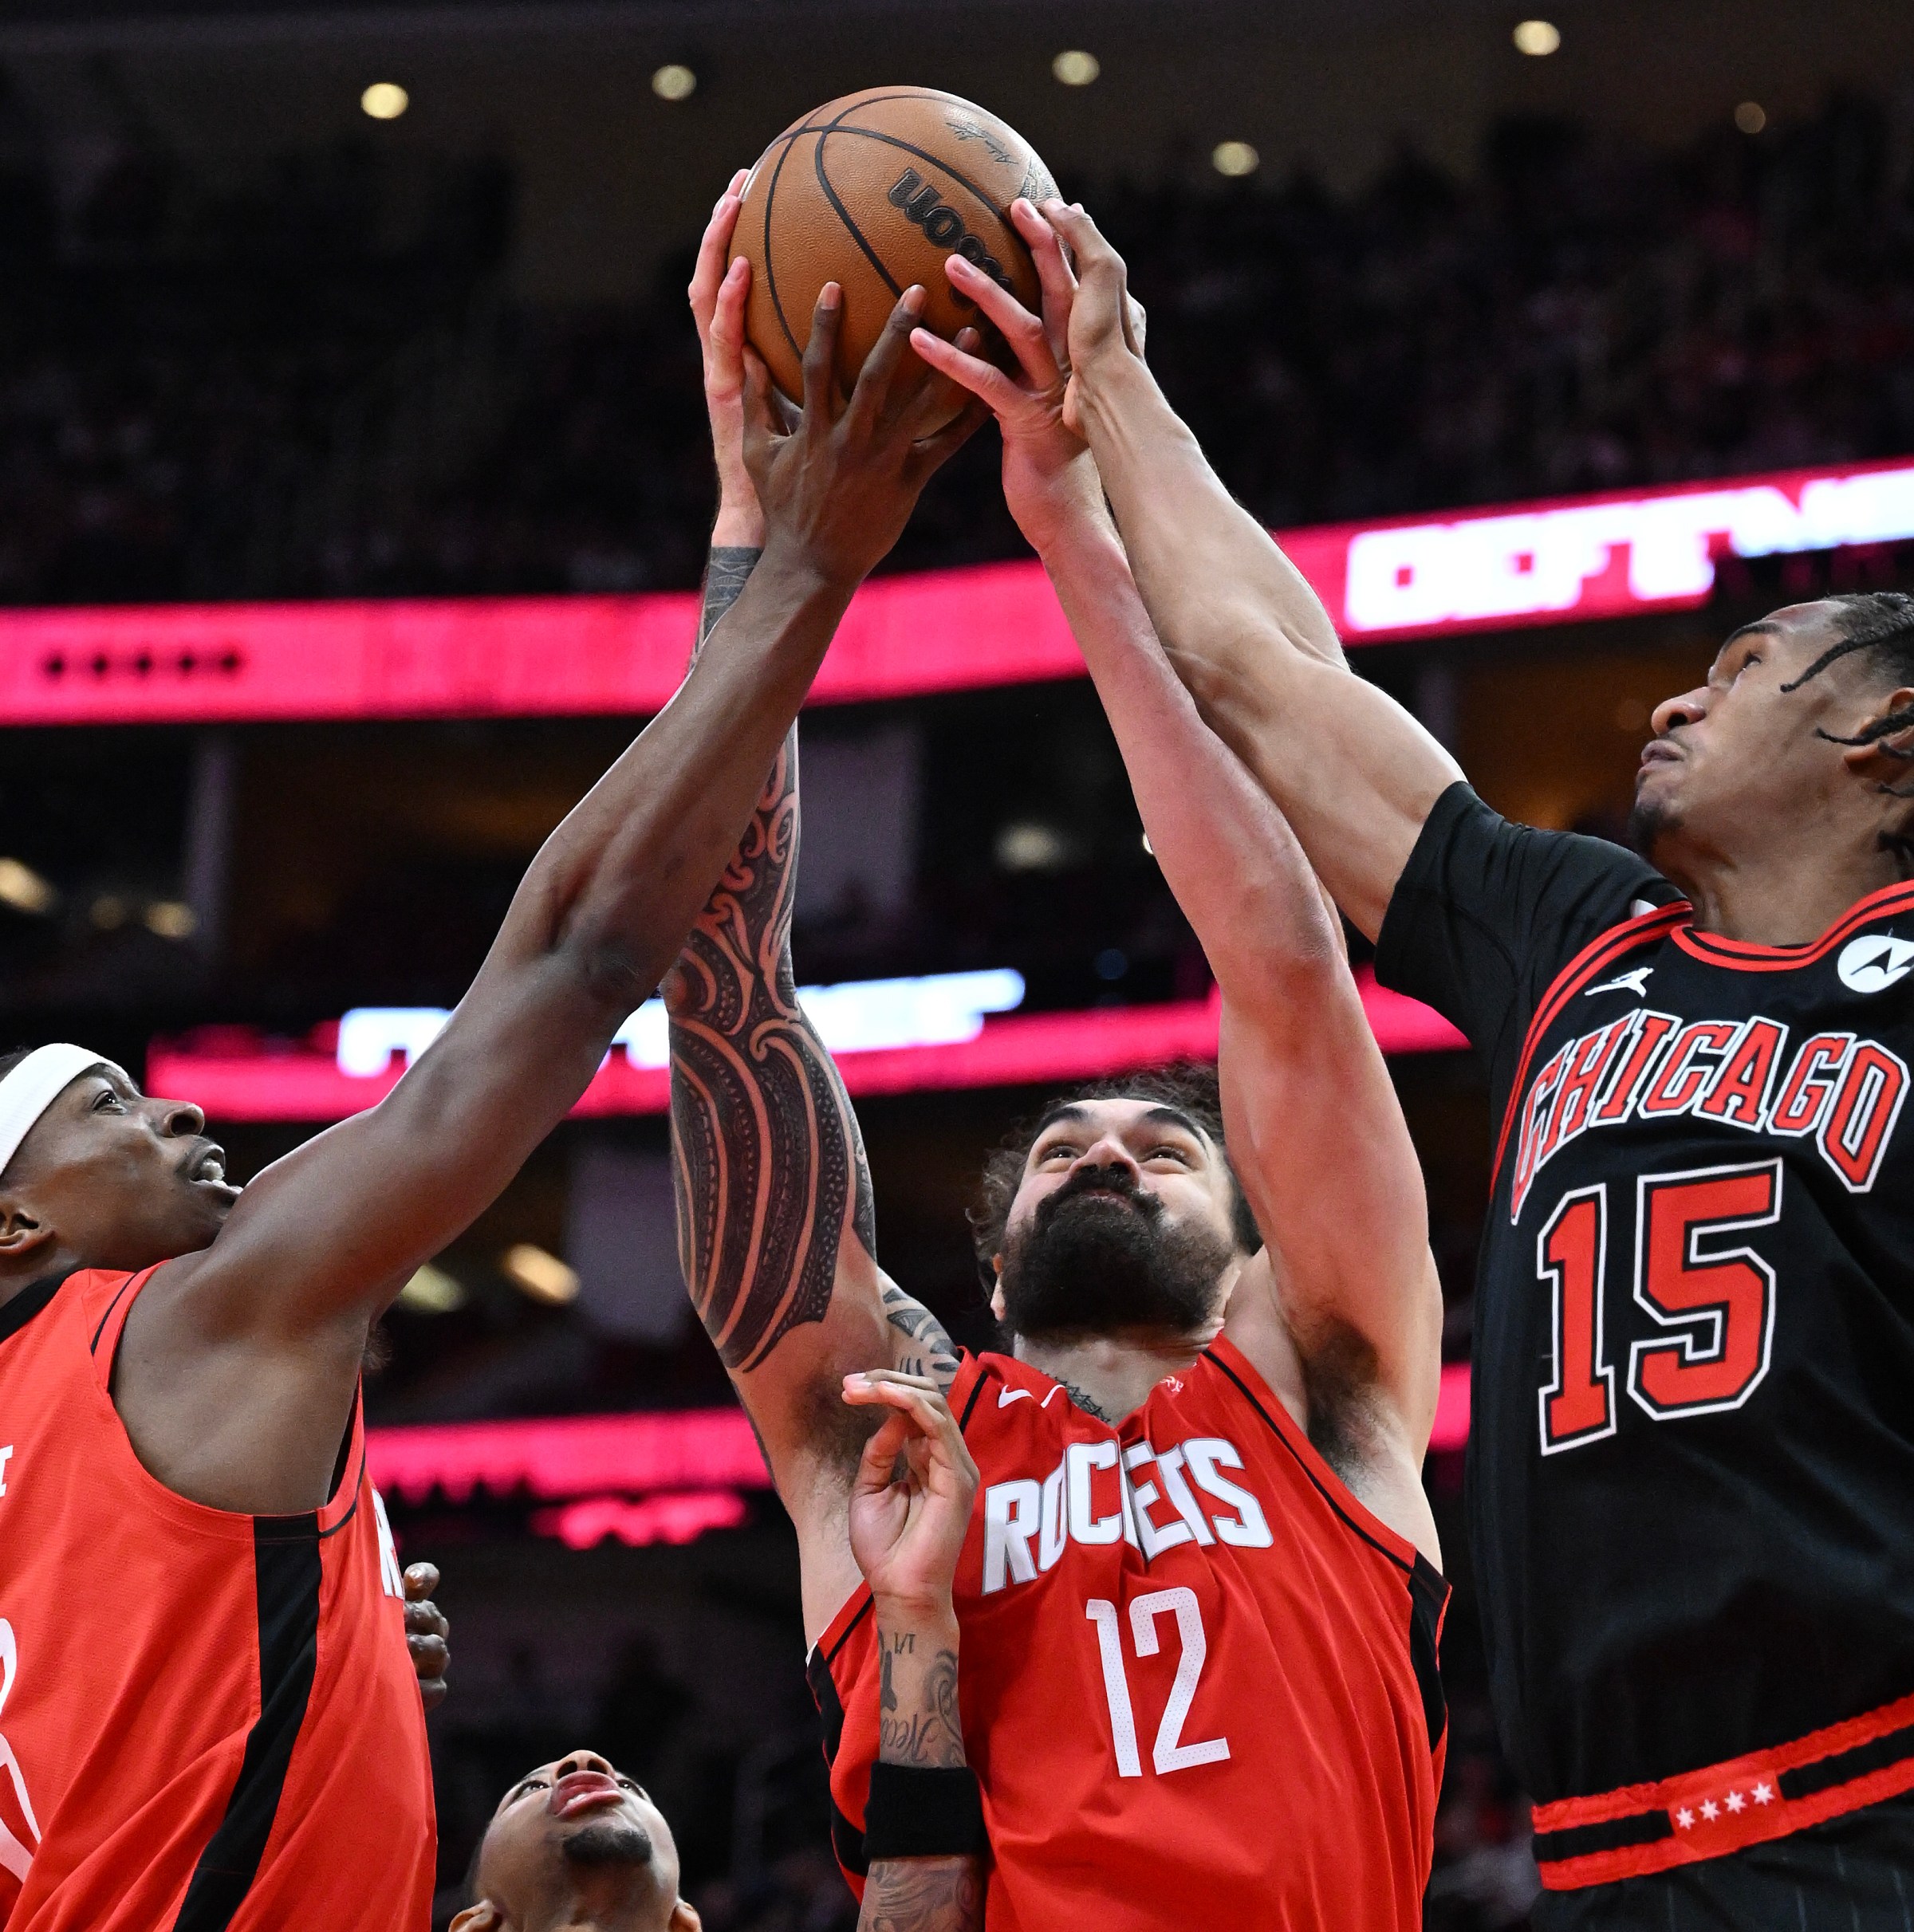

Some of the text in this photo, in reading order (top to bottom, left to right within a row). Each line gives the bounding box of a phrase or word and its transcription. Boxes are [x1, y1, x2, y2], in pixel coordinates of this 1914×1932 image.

[1511, 1008, 1910, 1225] CHICAGO
[1537, 1157, 1783, 1456] 15
[1085, 1586, 1231, 1777] 12
